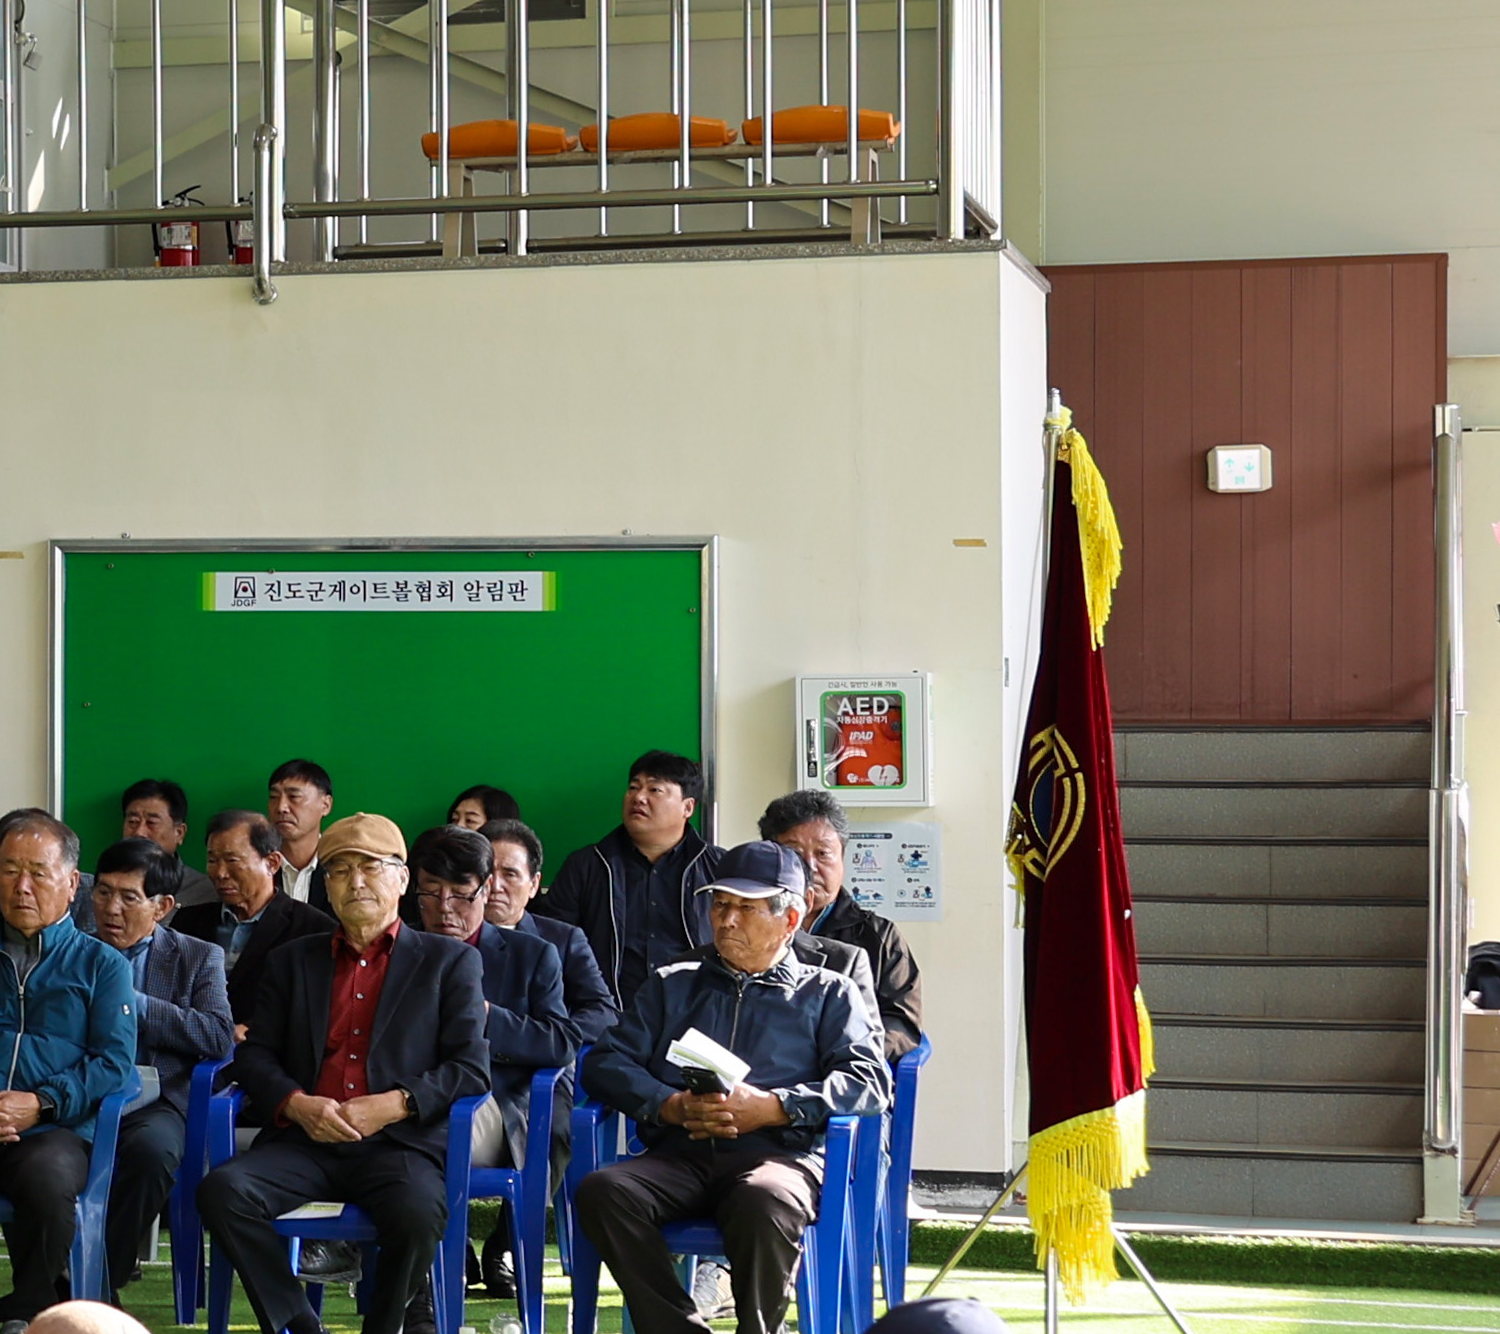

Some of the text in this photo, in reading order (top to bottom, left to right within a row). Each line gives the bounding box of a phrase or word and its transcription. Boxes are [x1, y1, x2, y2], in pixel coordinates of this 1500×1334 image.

[263, 579, 529, 603] 진도군게이트볼협회 알림판
[231, 598, 257, 607] JDGF
[836, 696, 890, 716] AED
